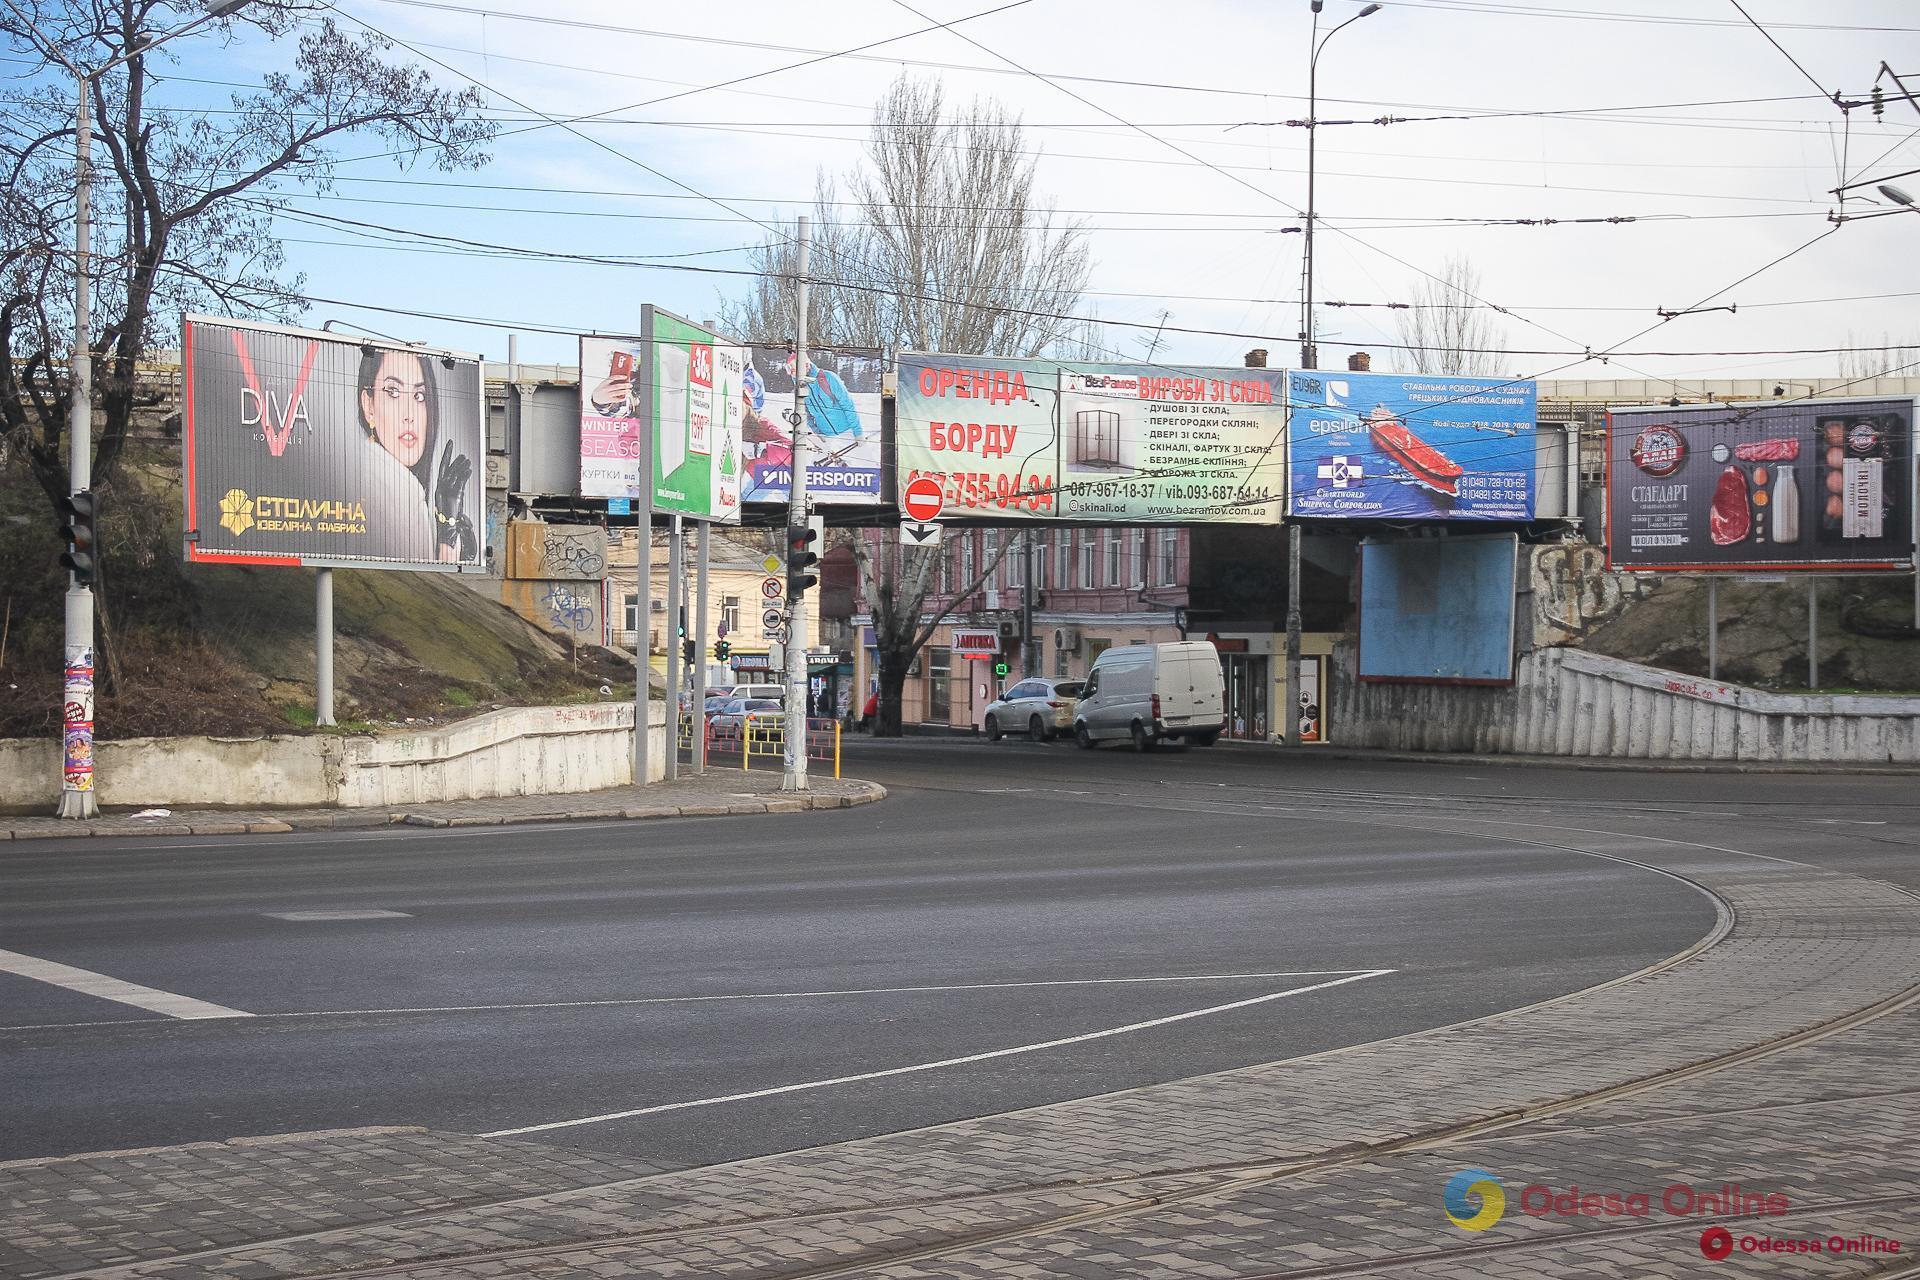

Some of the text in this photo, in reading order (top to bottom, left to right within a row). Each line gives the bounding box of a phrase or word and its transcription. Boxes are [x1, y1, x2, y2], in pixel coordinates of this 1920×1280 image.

[919, 367, 1028, 405] ОРЕНДА
[1139, 376, 1273, 403] ВИРОБИ ЗІ СКЛА
[1402, 383, 1446, 391] СТАБІЛЬНА
[1449, 383, 1480, 392] РОБОТА
[1496, 386, 1530, 394] СУДНАХ
[1408, 394, 1524, 405] ГРЕЦЬКИХ СУДНОВЛАСНИКІВ
[241, 387, 312, 432] DIVA
[1150, 405, 1230, 415] ДУШОВІ ЗІ СКЛА;
[582, 421, 629, 433] WINTER
[1150, 418, 1259, 429] ПЕРЕГОРОДКИ СКЛЯНІ;
[1310, 417, 1369, 436] epsilon
[930, 422, 1018, 459] БОРДУ
[1150, 431, 1178, 440] ДВЕРІ
[1192, 432, 1220, 440] СКЛА;
[1150, 443, 1191, 453] СКІНАЛІ,
[1194, 444, 1230, 453] ФАРТУК
[1150, 456, 1200, 465] БЕЗРАМНЕ
[582, 470, 620, 480] КУРТКИ
[778, 470, 875, 487] INERSPORT
[1070, 482, 1155, 498] 067-967-18-37
[1632, 484, 1688, 503] СТАНДАРТ
[1857, 470, 1868, 517] МОЛОЧНІ
[256, 496, 366, 521] СТОЛИЧНА
[1080, 502, 1266, 516] skinali.od www.bezramov.com.ua
[257, 520, 366, 534] ЮВЕЛІРНА ФАБРИКА
[1634, 536, 1676, 545] МОЛОЧНІ
